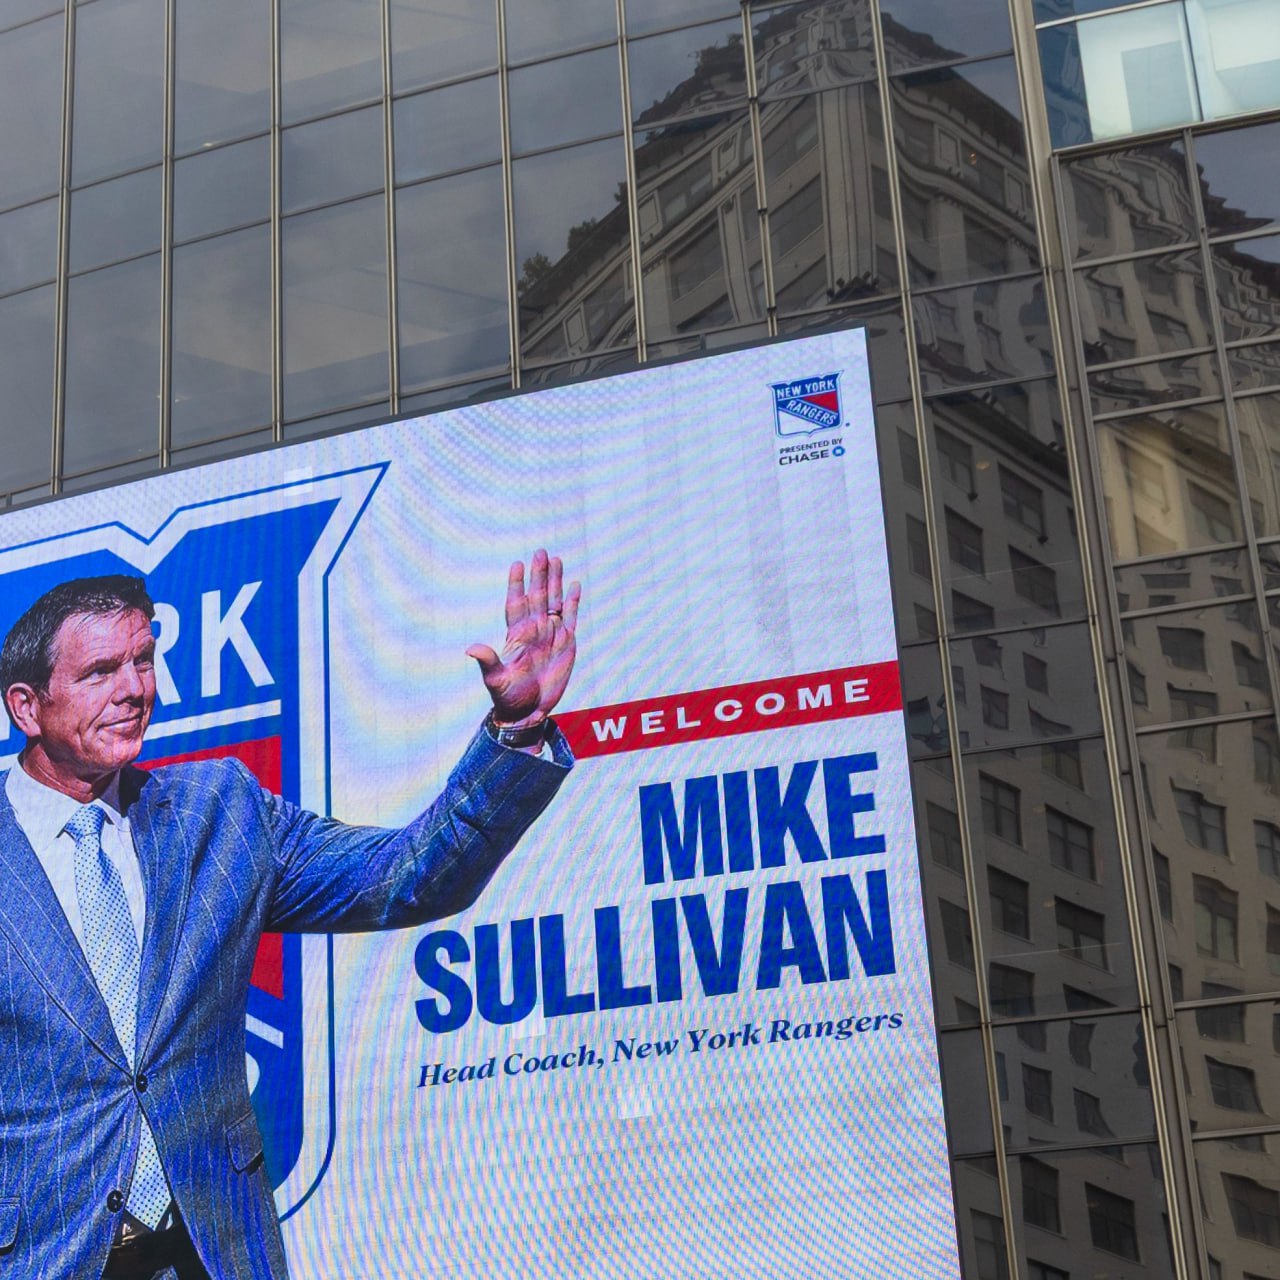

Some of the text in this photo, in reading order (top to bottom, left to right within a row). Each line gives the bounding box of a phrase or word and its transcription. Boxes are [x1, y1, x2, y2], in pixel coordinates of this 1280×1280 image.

[777, 379, 835, 399] NEW YORK
[786, 399, 836, 425] RANGERS
[779, 438, 843, 454] PRESENTED BY
[779, 449, 830, 465] CHASE
[591, 677, 871, 742] WELCOME
[638, 751, 887, 886] MIKE
[414, 869, 897, 1035] SULLIVAN
[417, 1009, 904, 1088] Head Coach, New York Rangers
